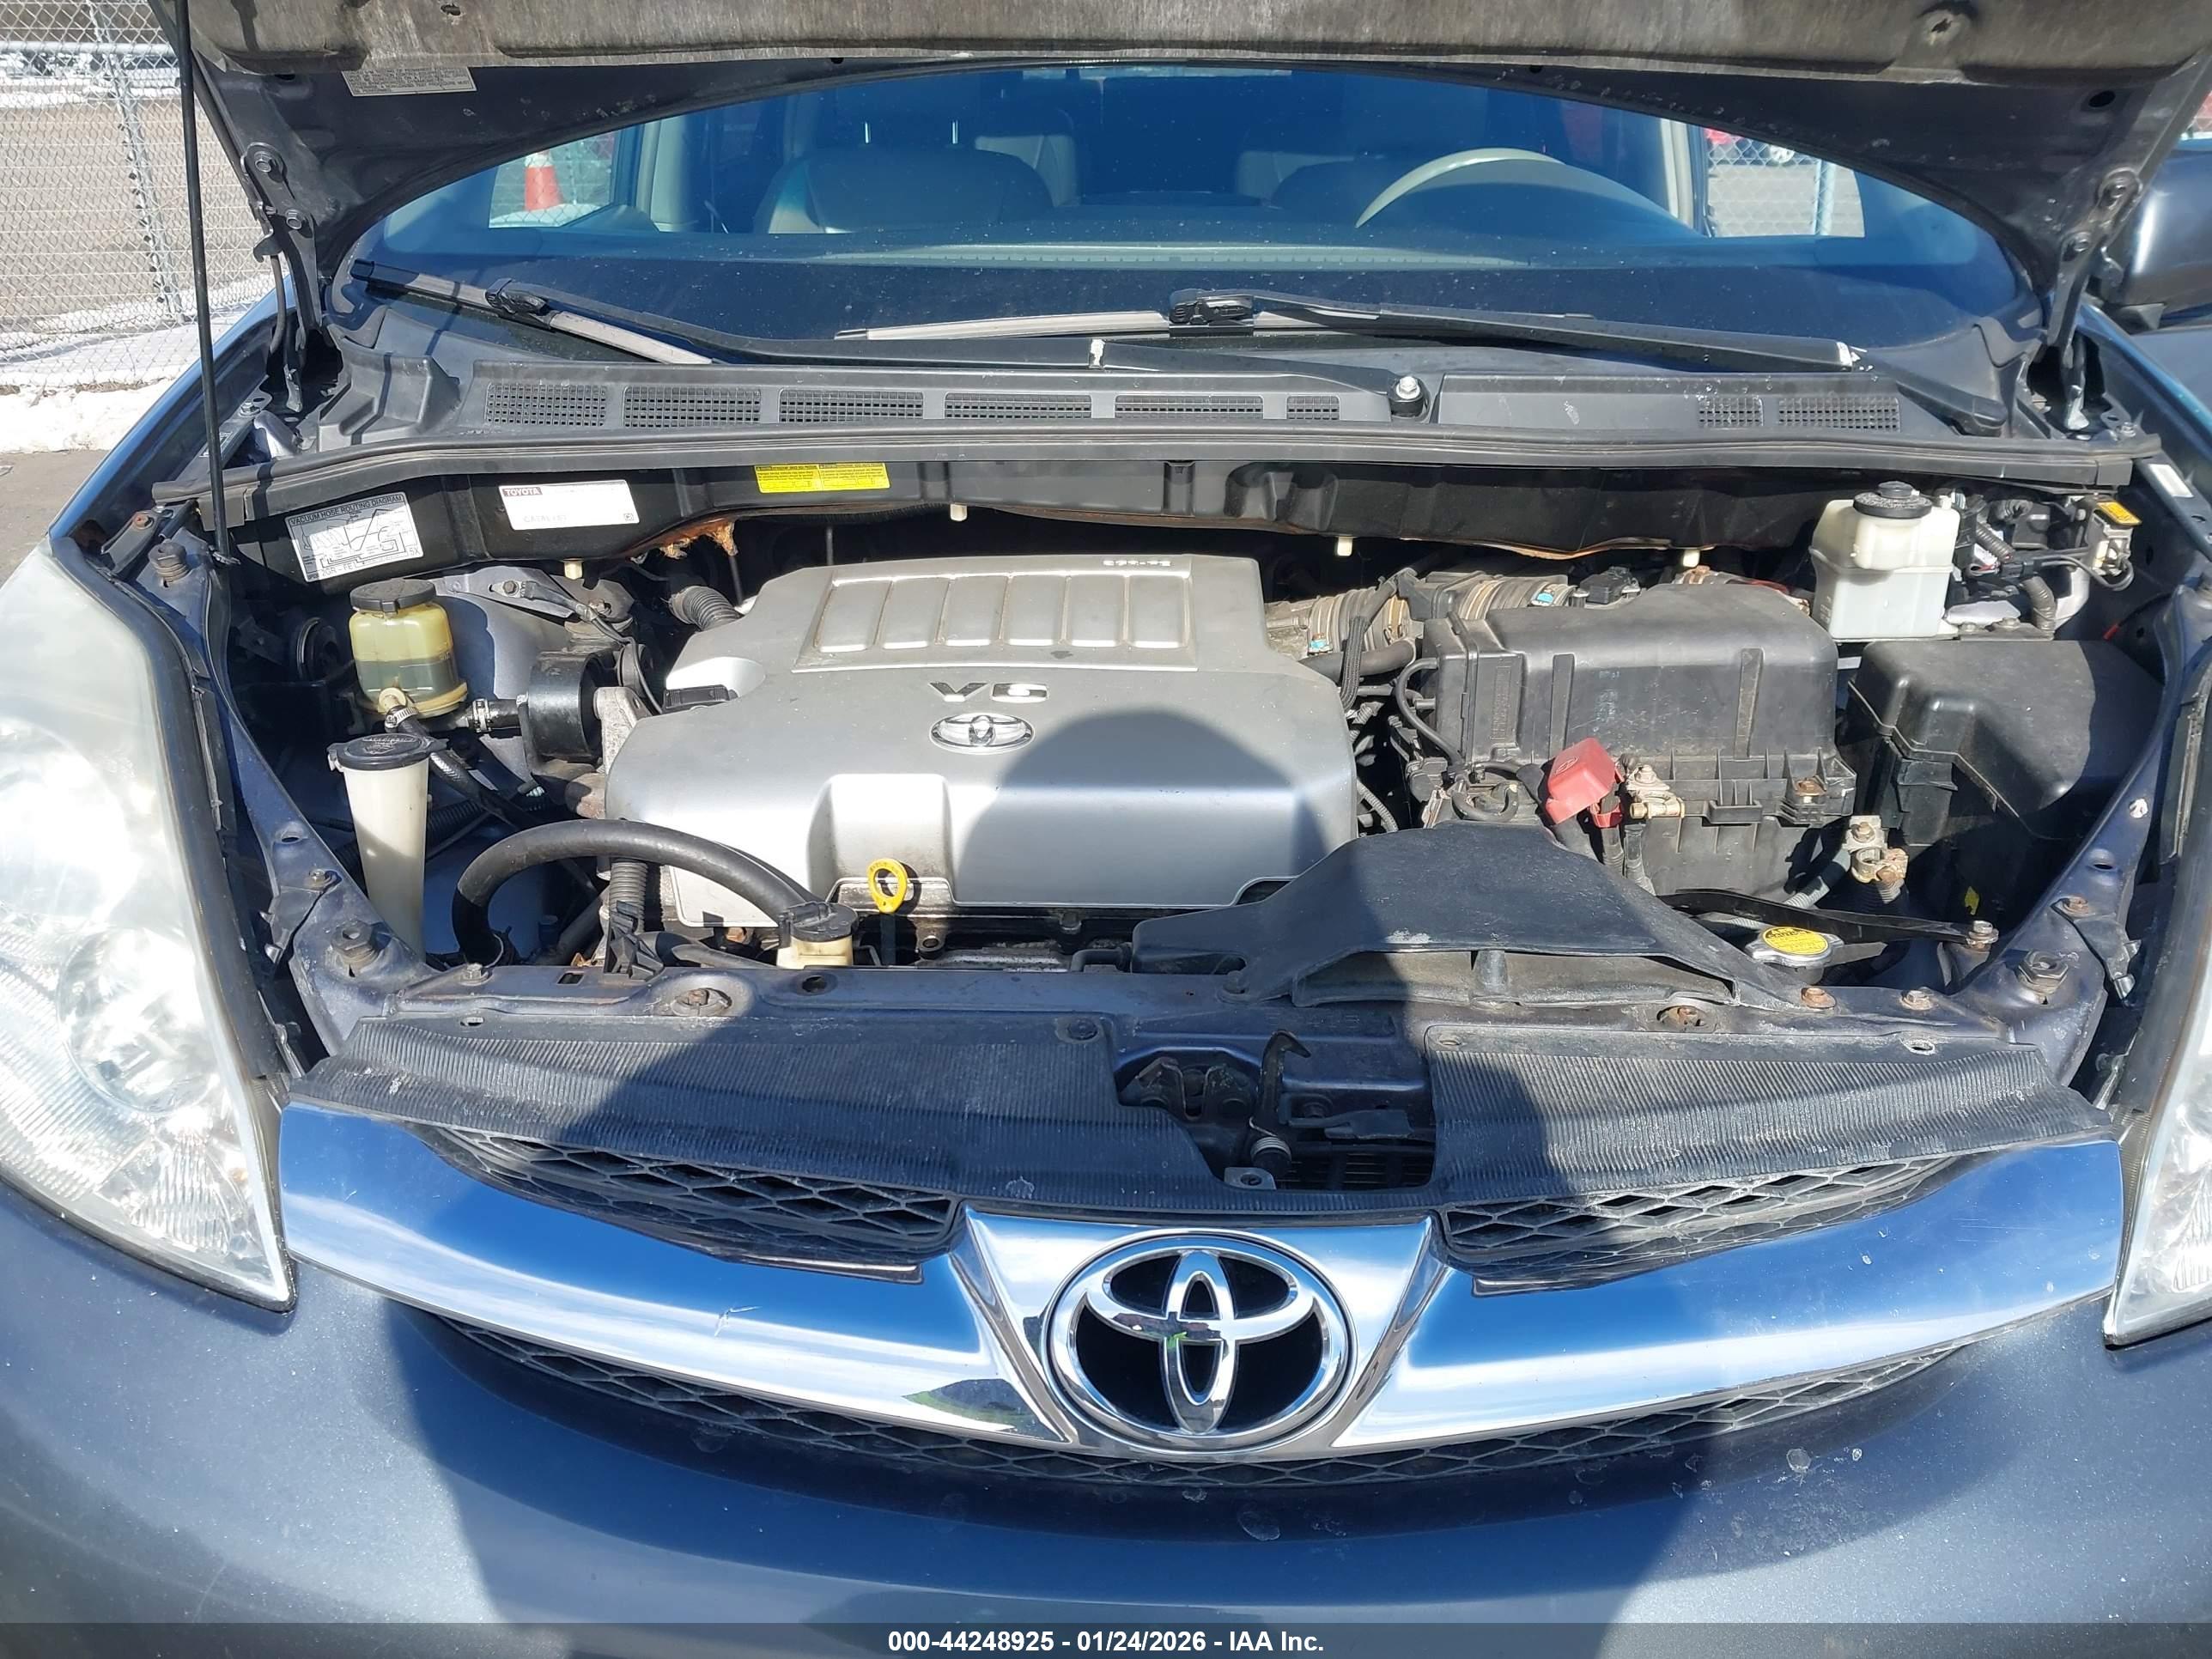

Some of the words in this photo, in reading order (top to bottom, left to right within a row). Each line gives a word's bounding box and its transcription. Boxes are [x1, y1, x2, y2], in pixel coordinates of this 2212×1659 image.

[504, 487, 540, 496] TOYOTA
[291, 514, 320, 526] VACUUM
[320, 508, 341, 519] HOSE
[341, 502, 371, 514] ROUTING
[372, 495, 402, 507] DIAGRAM
[928, 682, 1049, 702] V6
